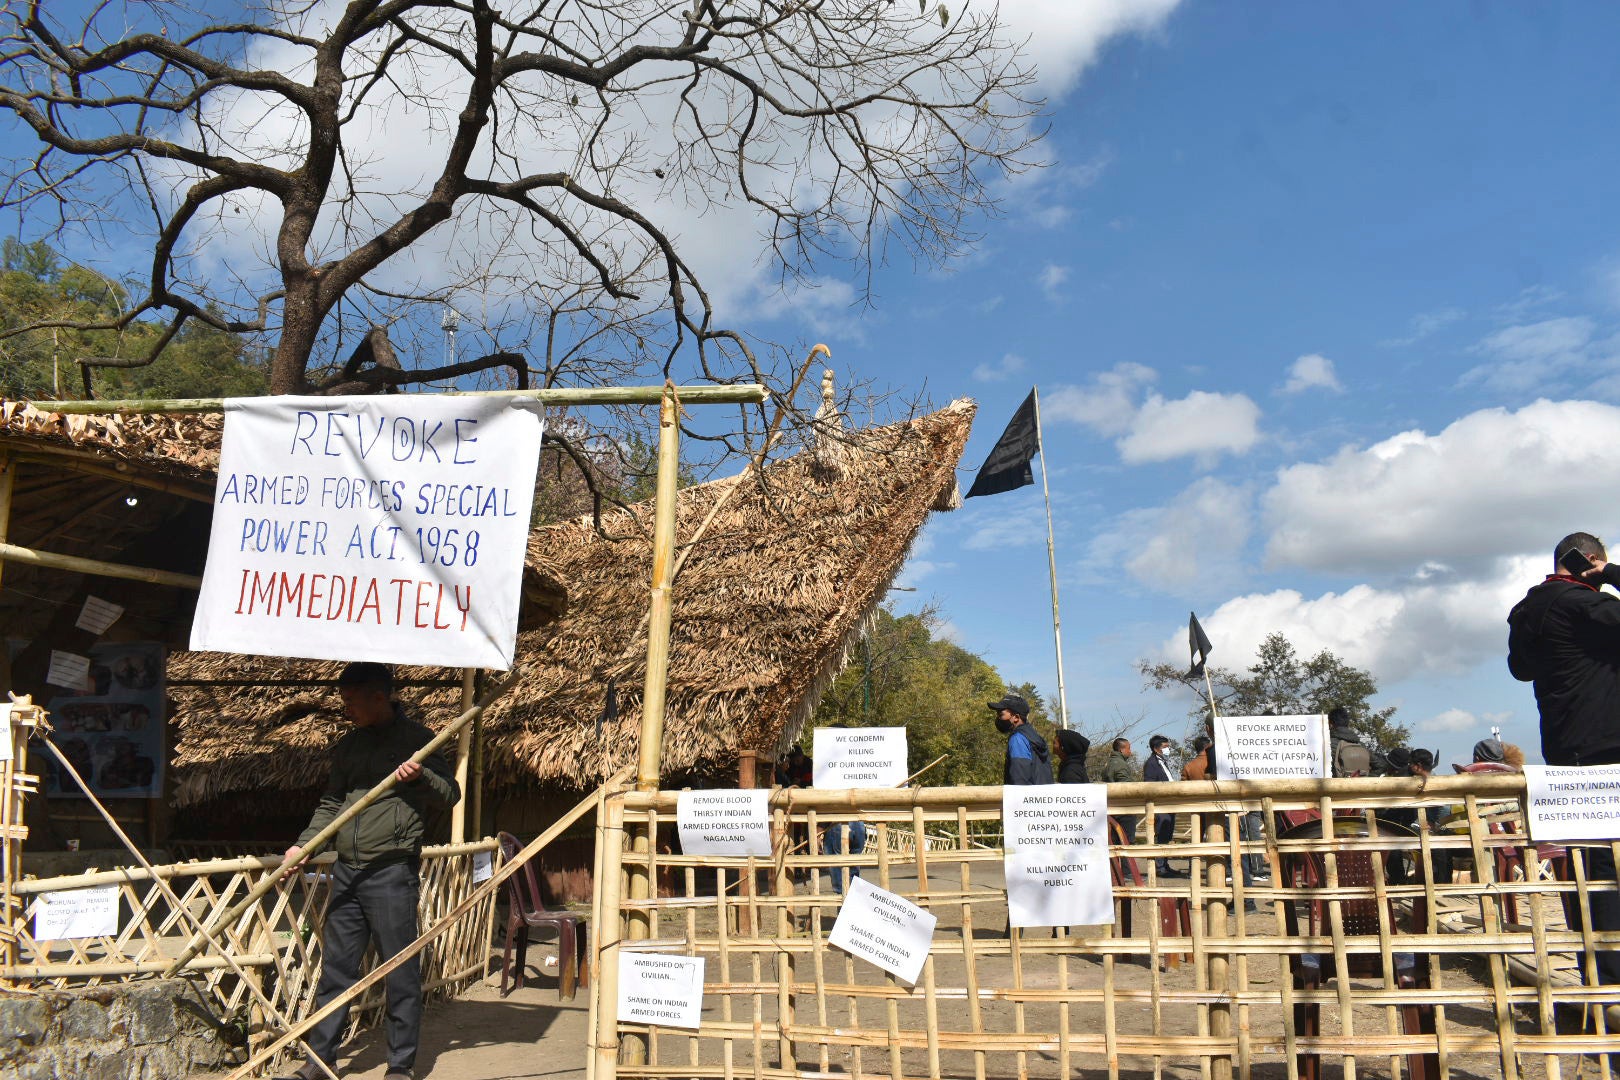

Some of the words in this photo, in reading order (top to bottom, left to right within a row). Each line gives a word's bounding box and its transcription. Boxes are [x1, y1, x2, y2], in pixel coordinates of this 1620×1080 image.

[291, 411, 478, 464] REVOKE
[220, 473, 309, 505] ARMED
[321, 476, 404, 511] FORCES
[416, 482, 517, 517] SPECIAL
[240, 518, 327, 556] POWER
[416, 526, 481, 567] 1958
[235, 569, 471, 631] IMMEDIATELY
[1282, 752, 1318, 762] (AFSPA),
[856, 760, 892, 768] INNOCENT
[1230, 766, 1250, 774] 1958
[1572, 797, 1606, 805] FORCES
[1045, 864, 1088, 873] INNOCENT
[1044, 879, 1073, 887] PUBLIC
[870, 892, 907, 914] AMBUSHED
[907, 910, 917, 920] ON
[849, 938, 874, 954] ARMED
[850, 925, 874, 940] SHAME
[875, 937, 886, 946] ON
[887, 943, 910, 958] INDIAN
[635, 960, 672, 968] AMBUSHED
[628, 996, 650, 1004] SHAME
